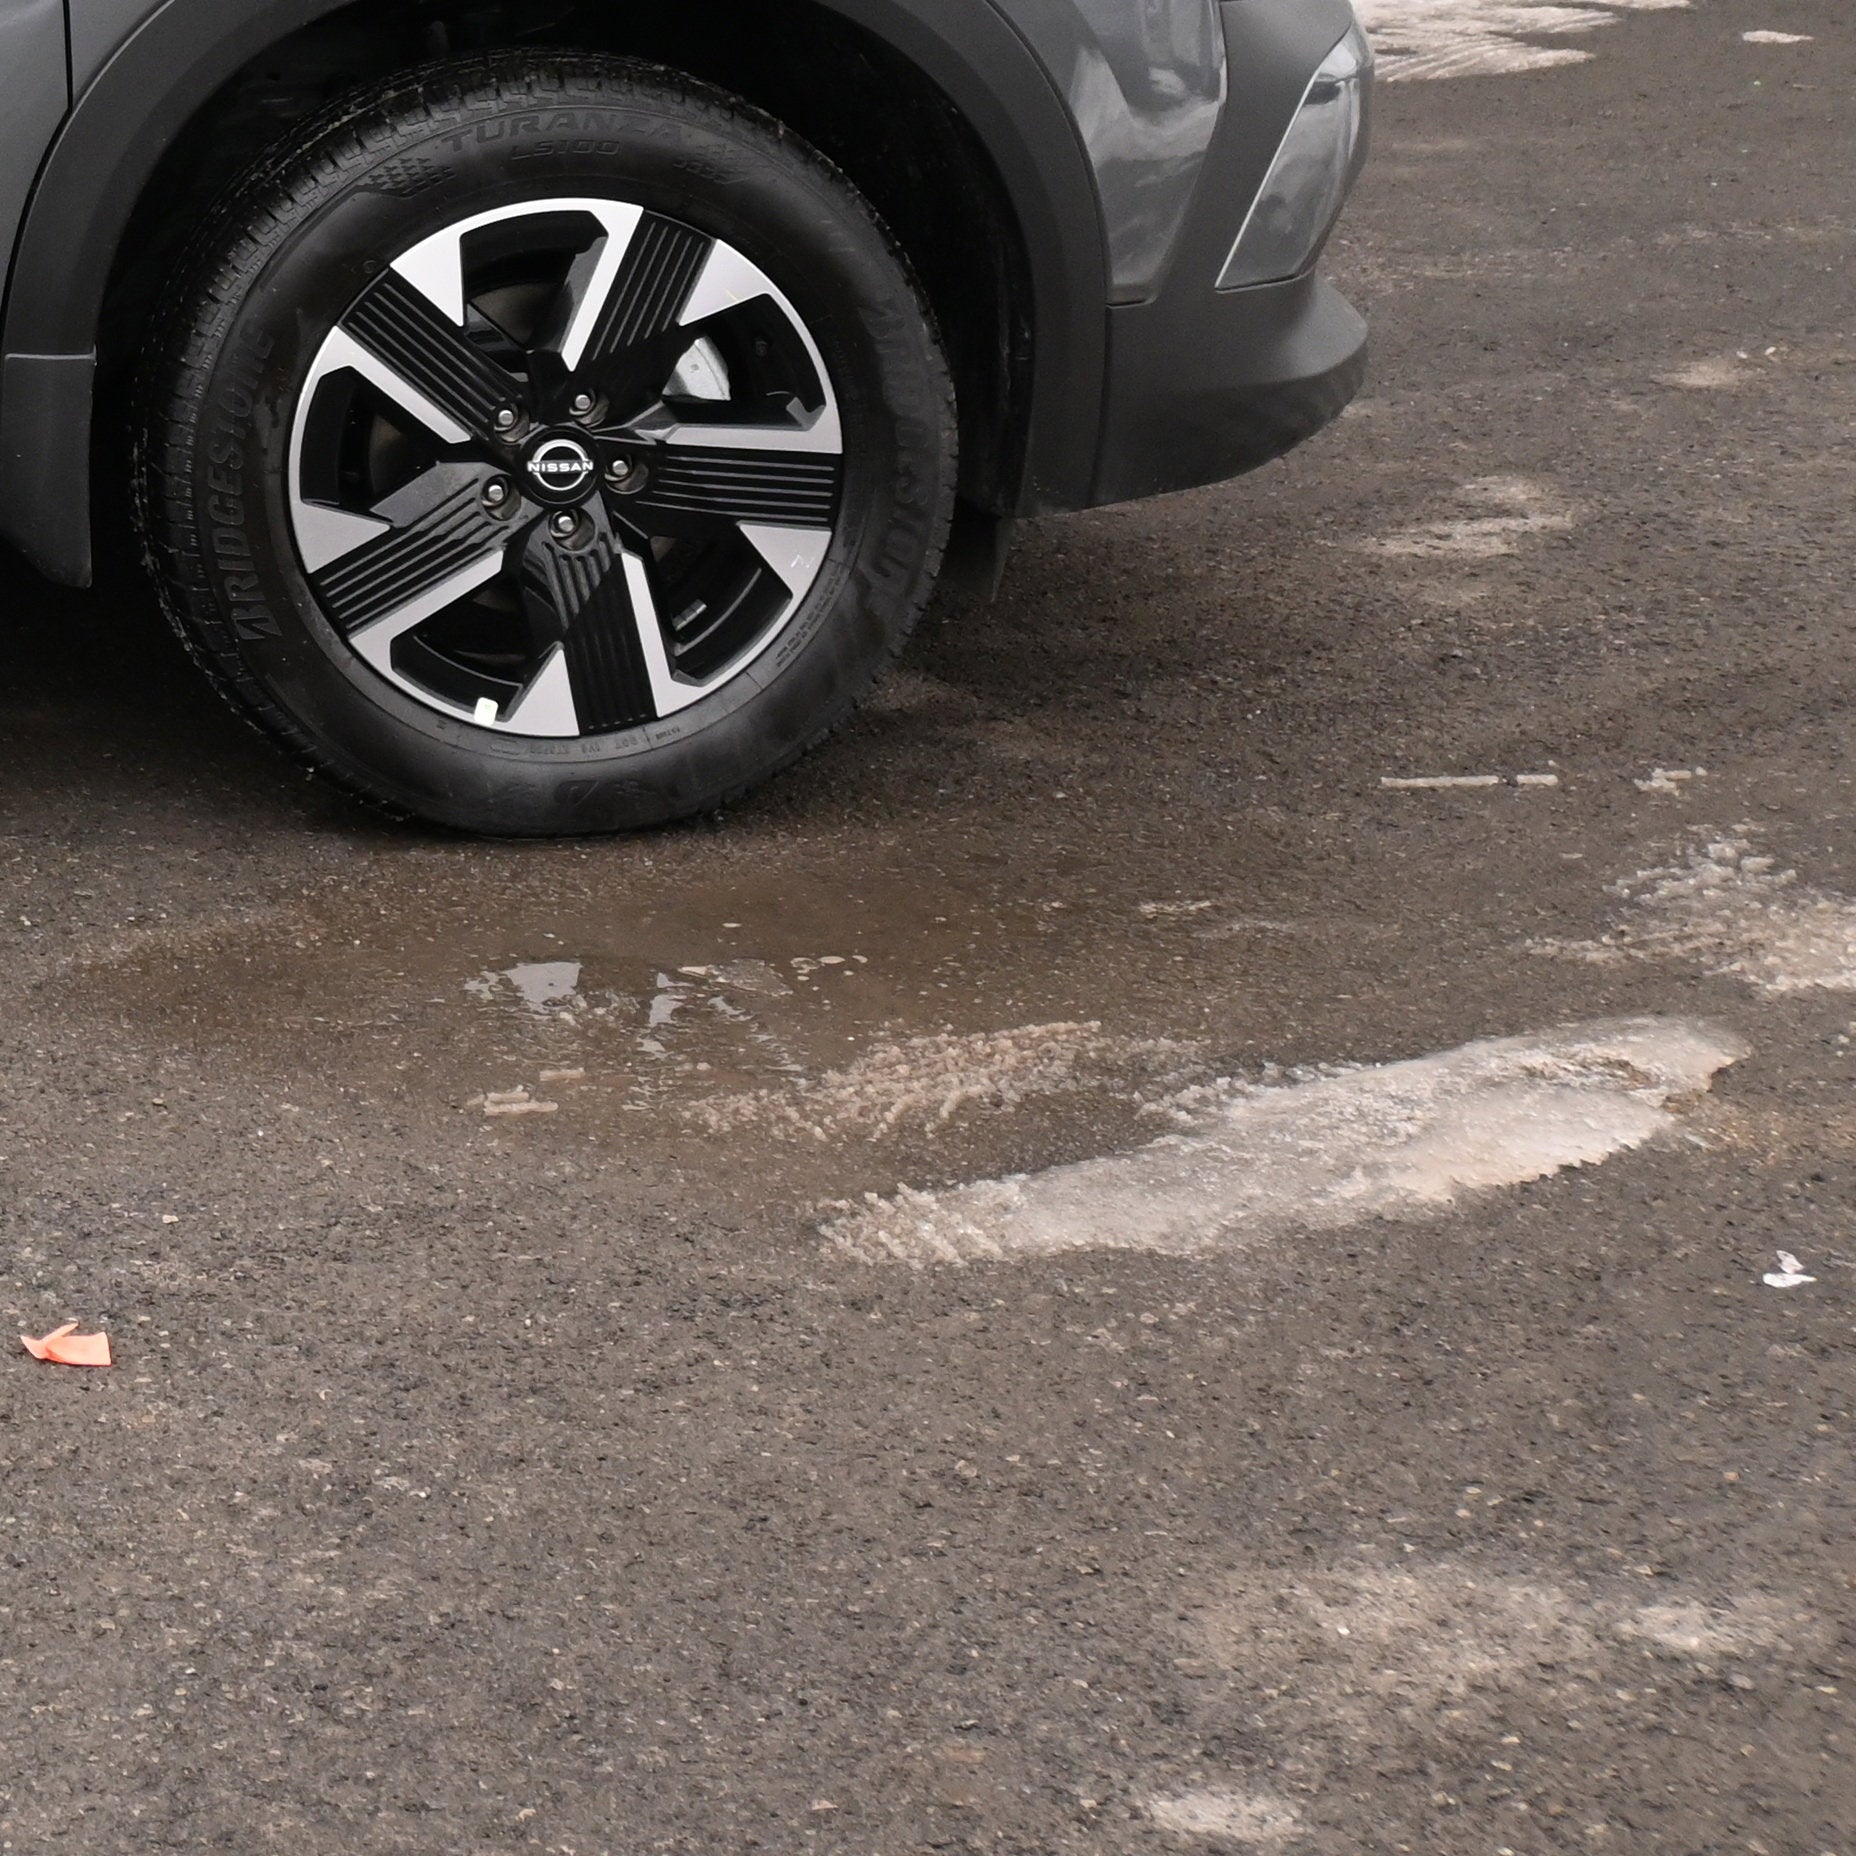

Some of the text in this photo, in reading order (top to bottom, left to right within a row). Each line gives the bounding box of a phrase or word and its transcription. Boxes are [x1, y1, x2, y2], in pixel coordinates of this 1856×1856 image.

[439, 112, 684, 153] TURANZA
[206, 327, 284, 641] BRIDGESTONE
[527, 460, 594, 473] NISSAN
